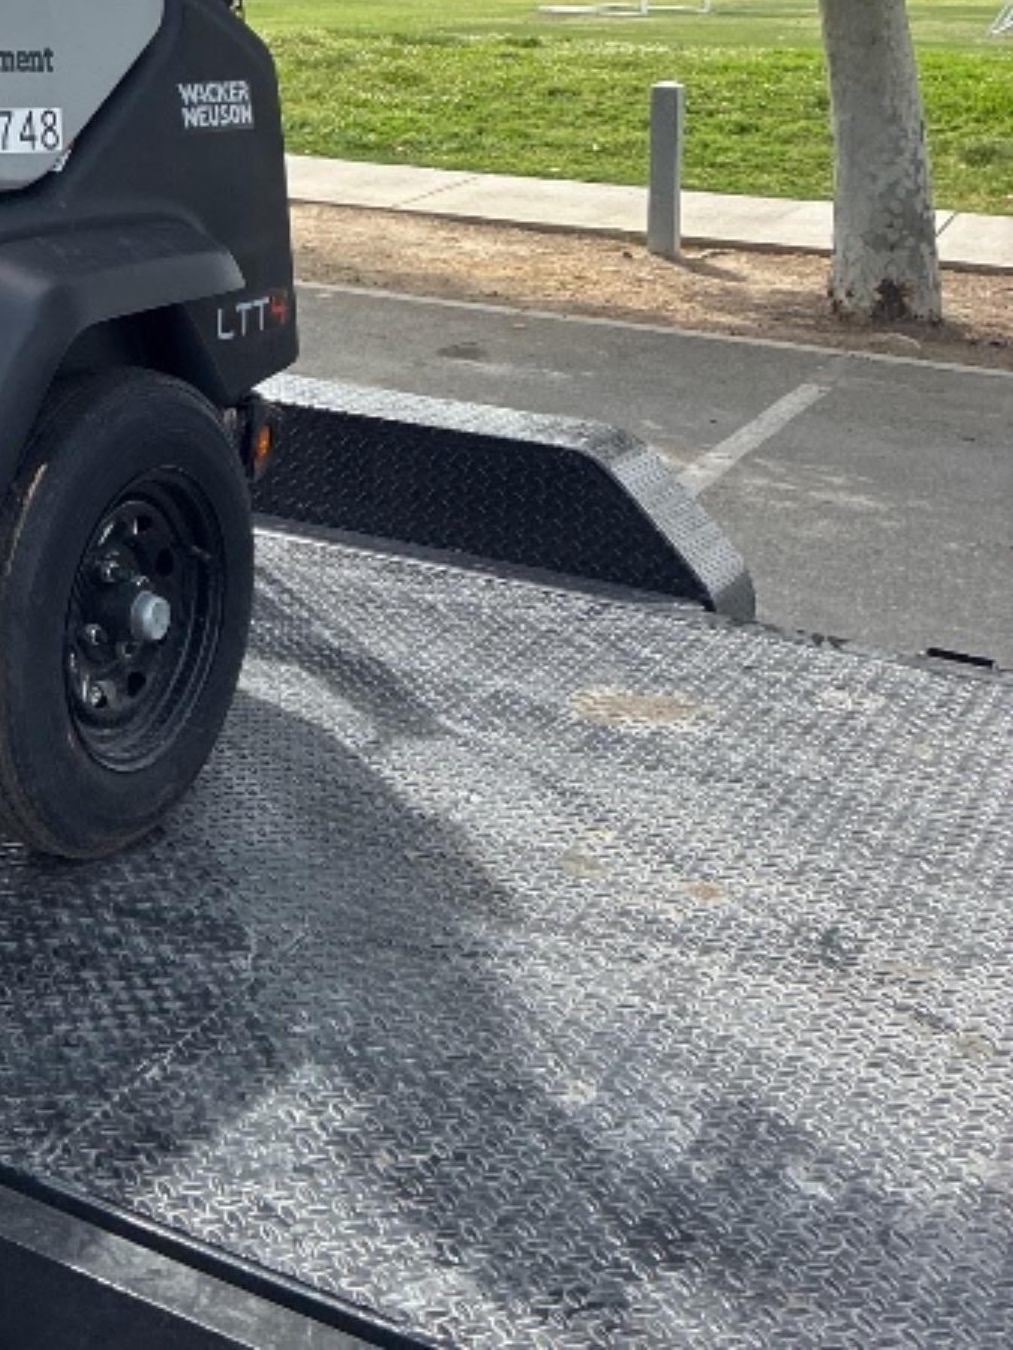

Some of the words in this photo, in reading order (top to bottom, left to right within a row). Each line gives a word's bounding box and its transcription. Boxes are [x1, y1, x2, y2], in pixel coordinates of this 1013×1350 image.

[175, 80, 250, 105] WACKER
[181, 103, 254, 130] NEUSON
[216, 294, 288, 341] LTT4
